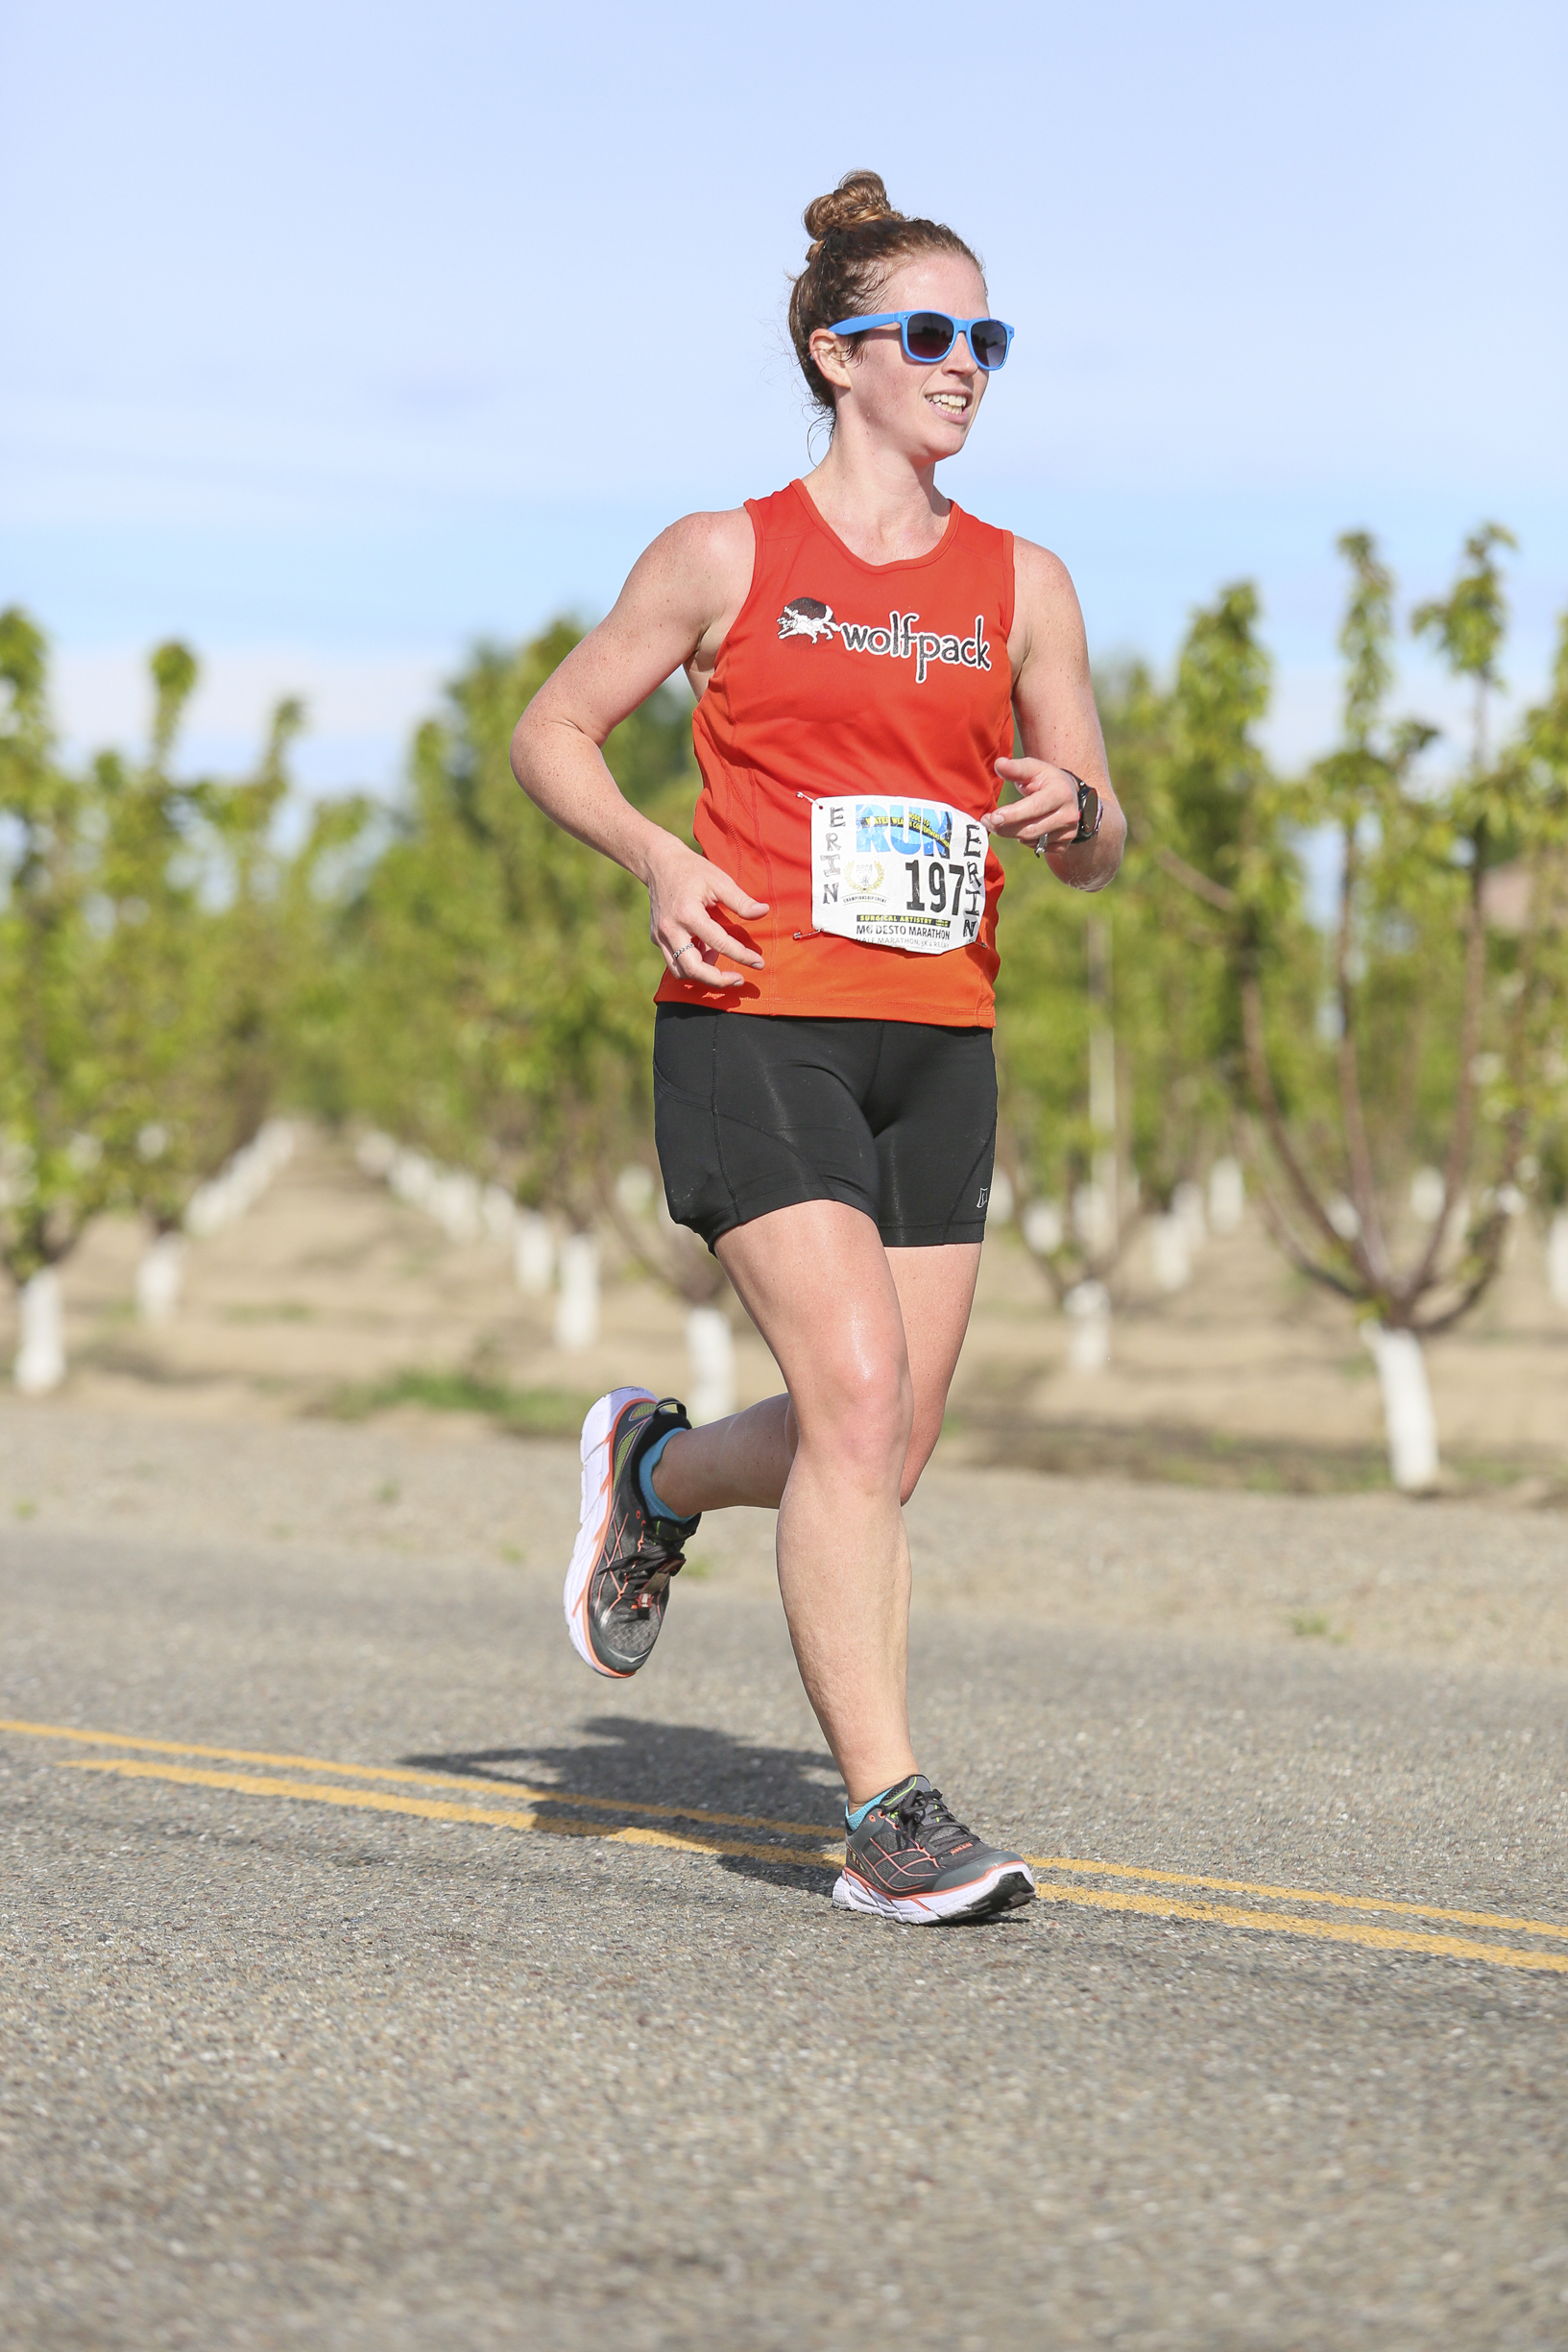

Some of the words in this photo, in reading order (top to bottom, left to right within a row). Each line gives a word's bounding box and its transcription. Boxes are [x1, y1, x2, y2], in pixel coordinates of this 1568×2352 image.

[840, 611, 991, 684] wolfpack
[820, 807, 846, 905] ERIN
[856, 803, 953, 860] RUN
[905, 860, 965, 916] 197
[963, 824, 982, 937] ERIN
[900, 916, 932, 926] ARTISTRY
[908, 926, 951, 940] MARATHON
